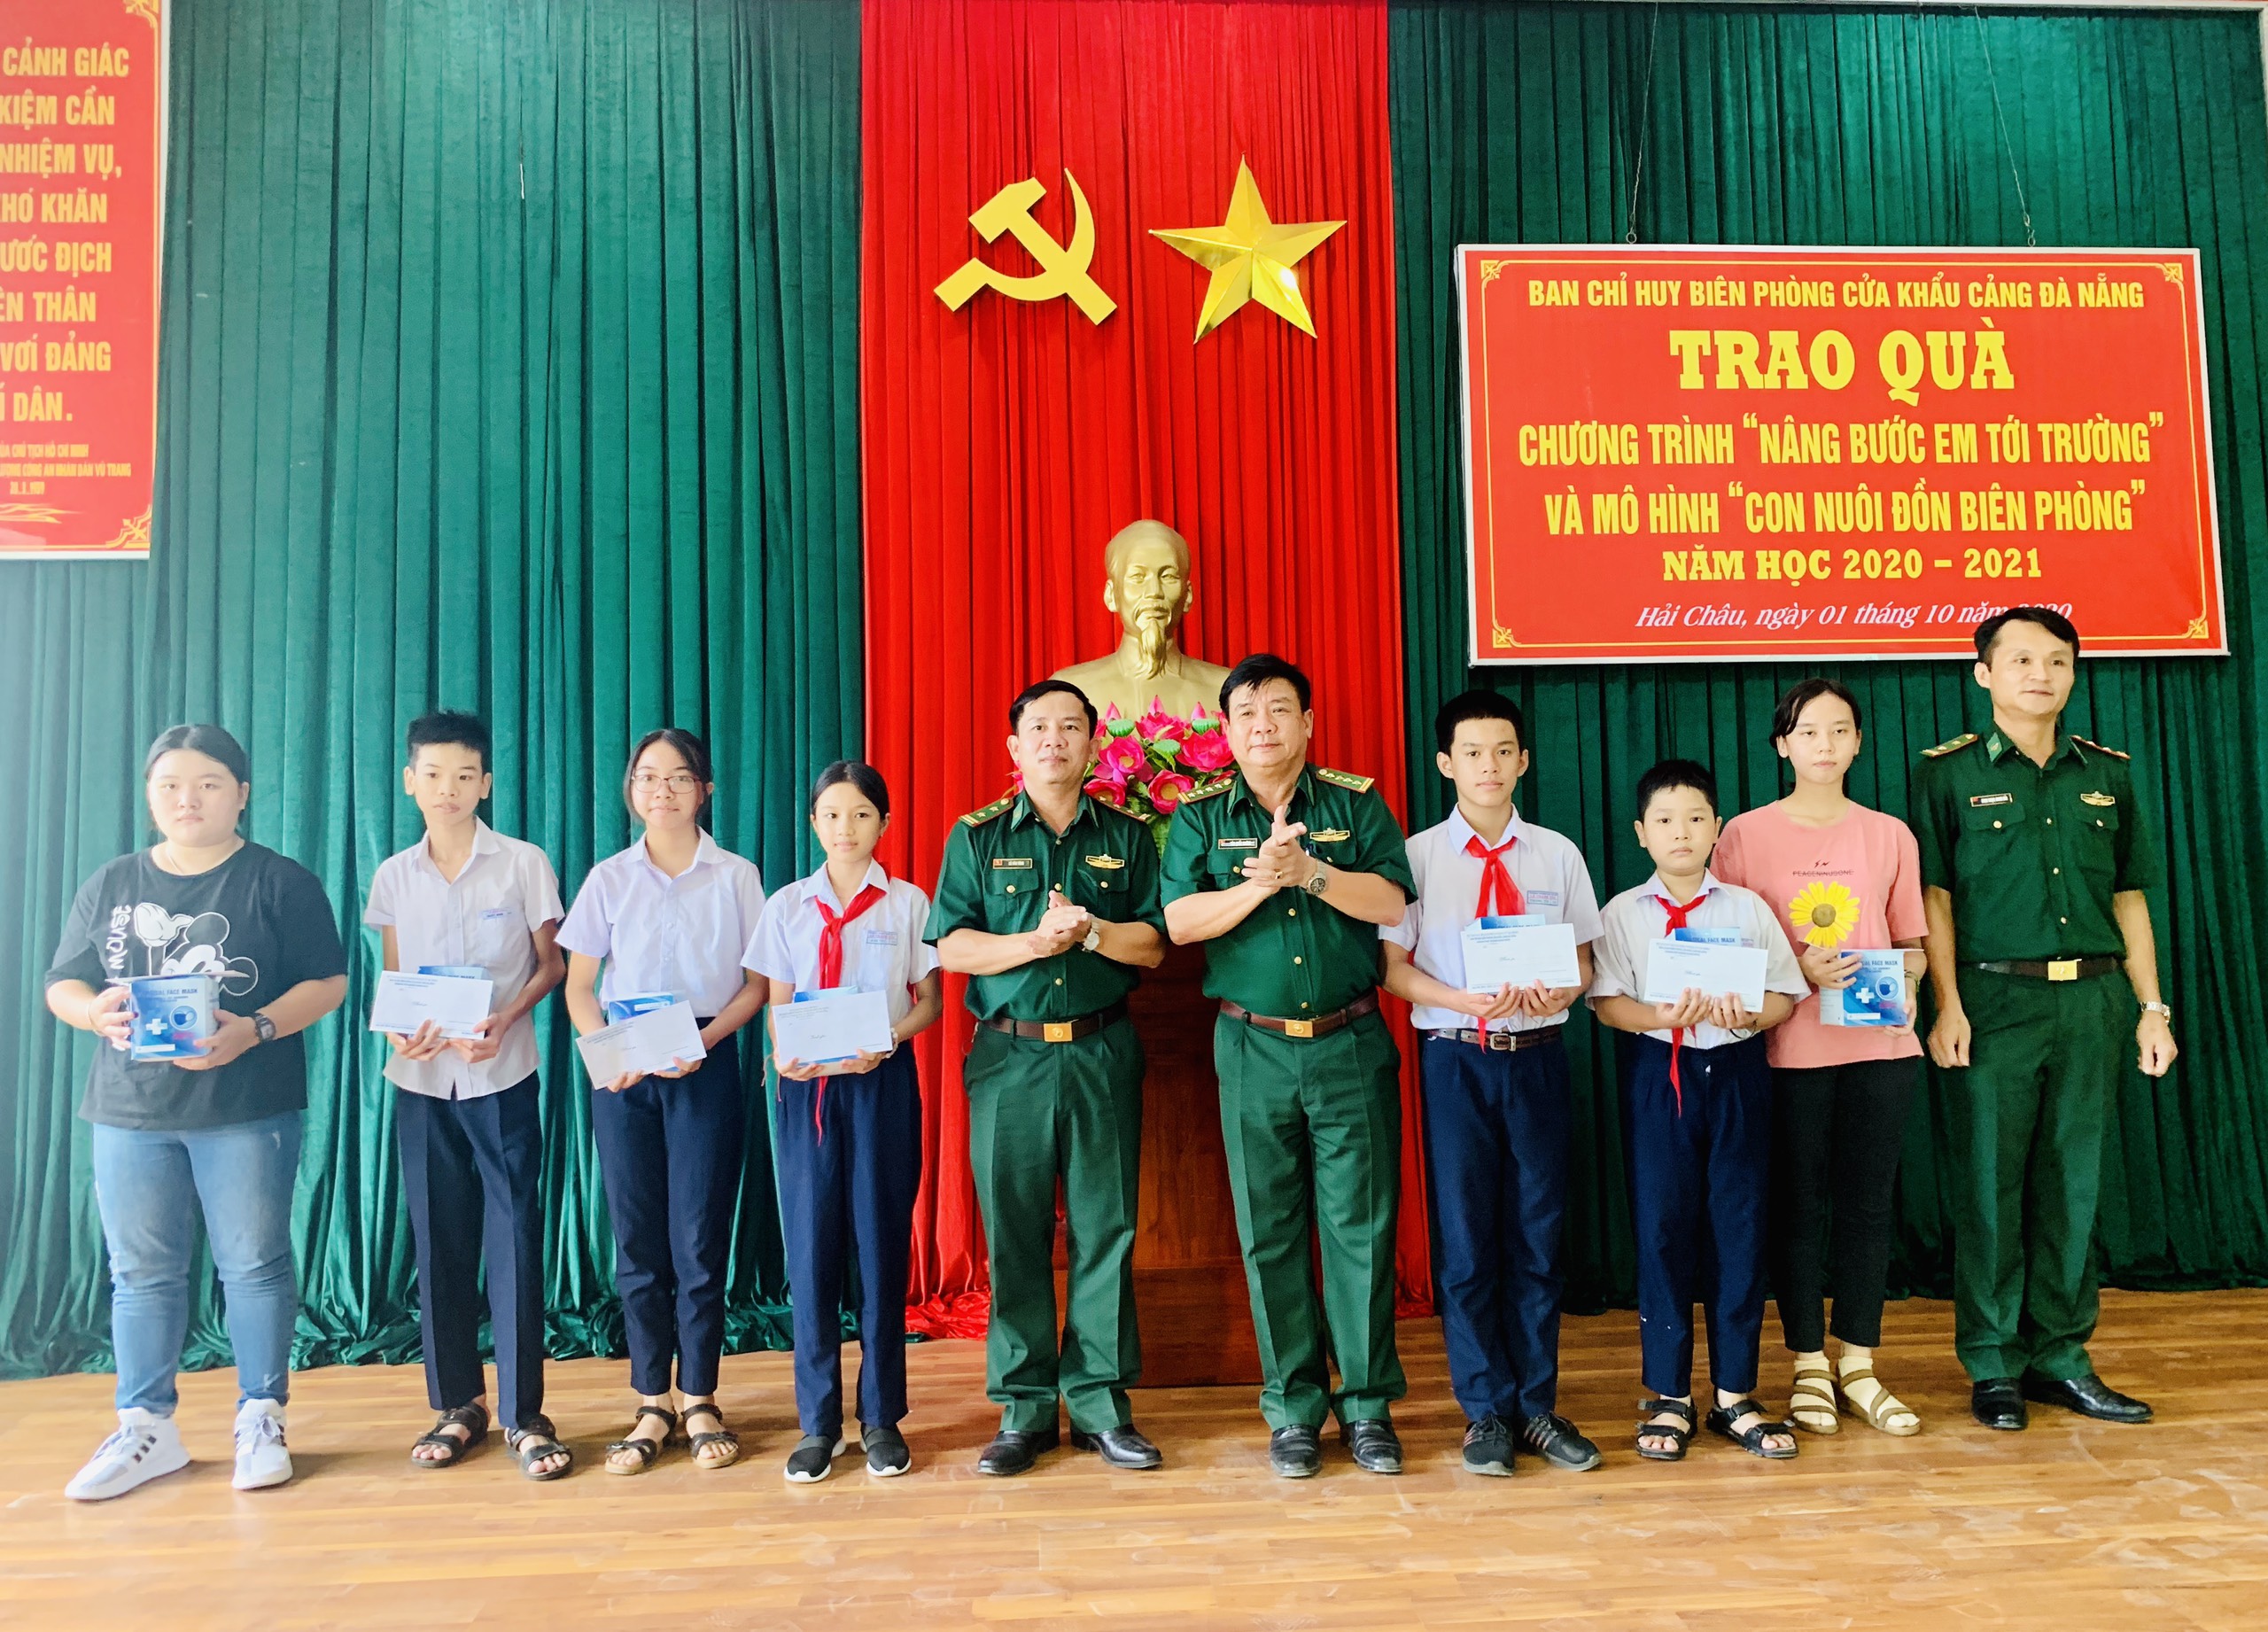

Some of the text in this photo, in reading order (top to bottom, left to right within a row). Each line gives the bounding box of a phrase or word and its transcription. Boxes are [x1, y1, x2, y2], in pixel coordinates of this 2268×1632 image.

[2, 36, 129, 78] CẢNH GIÁC
[0, 136, 122, 181] NHIỆM VỤ,
[0, 187, 108, 223] HÓ KHĂN
[55, 241, 112, 277] ĐỊCH
[32, 284, 97, 323] THÂN
[1529, 272, 2144, 307] BAN CHỈ HUY BIÊN PHÒNG CỬA KHẨU CẢNG ĐÀ NẴNG
[45, 330, 112, 372] ĐẢNG
[1670, 317, 2014, 406] TRAO QUÀ
[13, 385, 73, 422] DÂN.
[1519, 421, 1639, 466] CHƯƠNG
[1648, 416, 1734, 464] TRÌNH
[1850, 415, 1925, 463] BƯỚC
[1935, 424, 1977, 462] EM
[1985, 415, 2030, 462] TỚI
[1545, 486, 1584, 534] VÀ
[1593, 485, 1639, 534] MÔ
[1649, 485, 1719, 533] HÌNH
[1814, 483, 1883, 532] NUÔI
[1891, 478, 1951, 532] ĐỒN
[1960, 483, 2026, 531] BIÊN
[1663, 544, 1744, 580] NĂM
[1756, 549, 1830, 587] HỌC
[1844, 549, 1922, 579] 2020
[1964, 548, 2041, 578] 2021
[1635, 603, 1680, 626] Hải
[1684, 603, 1746, 628] Châu,
[1753, 601, 1815, 631] ngày
[1817, 605, 1847, 626] 01
[1854, 602, 1921, 628] tháng
[1925, 604, 1954, 623] 10
[106, 905, 132, 969] MOUSE
